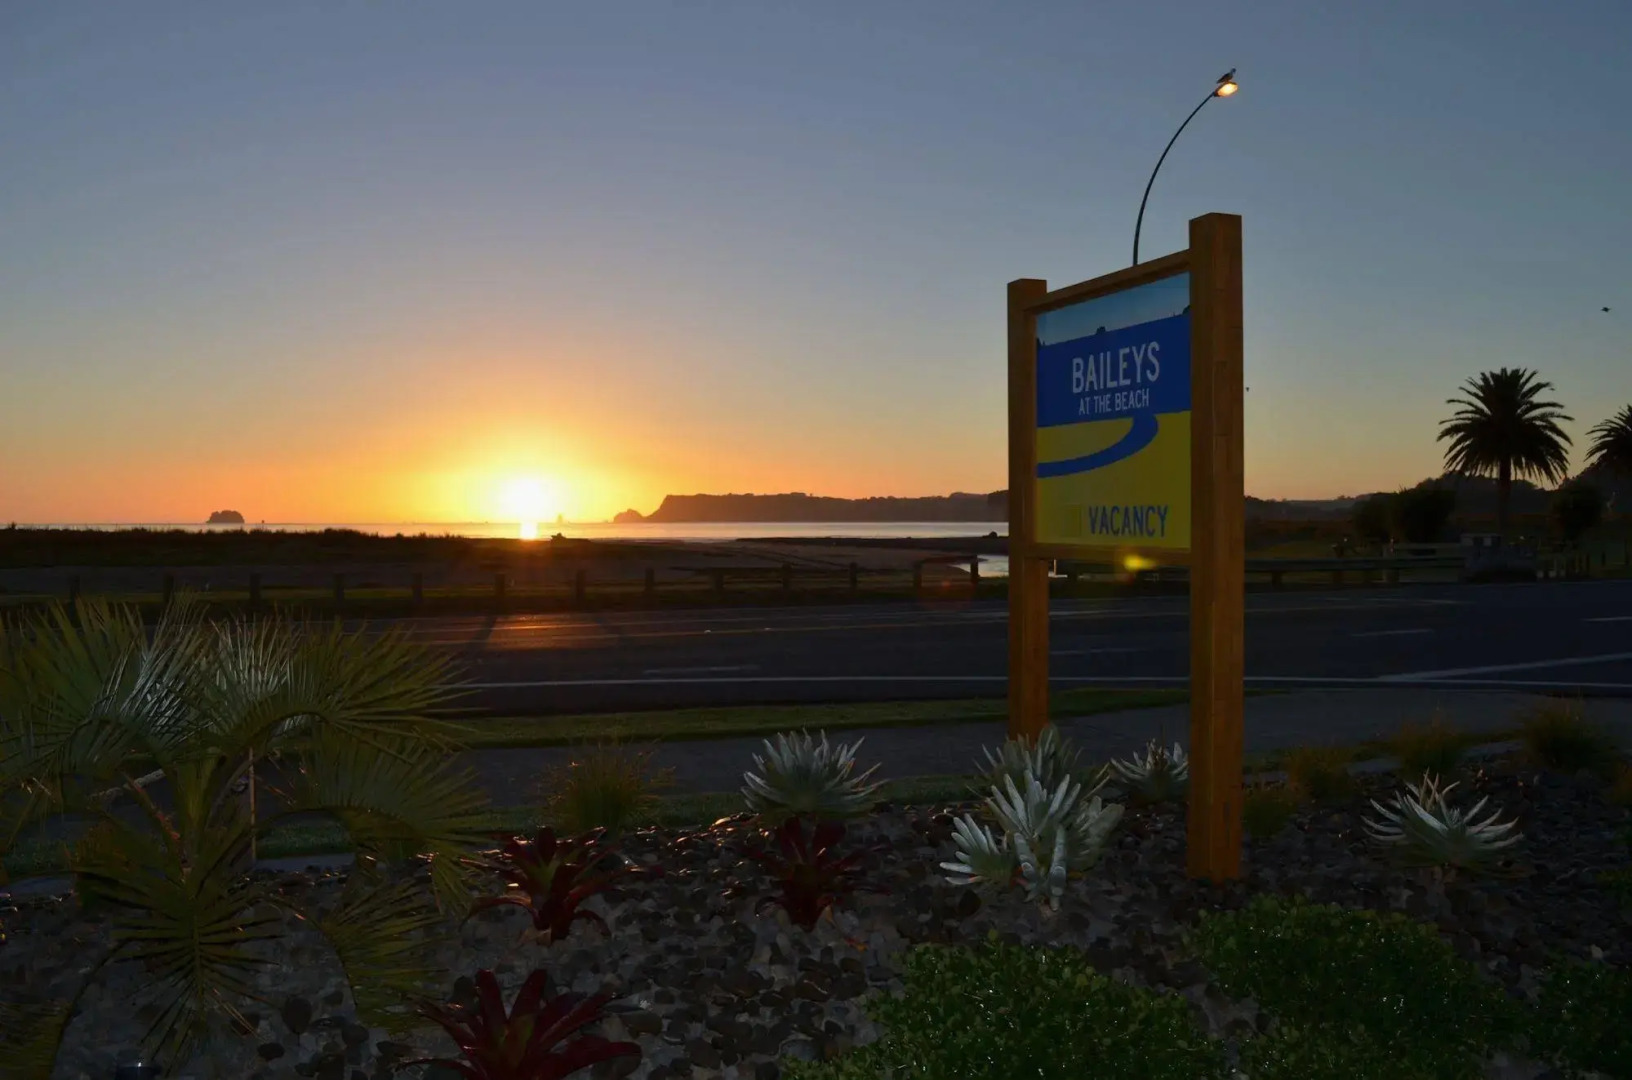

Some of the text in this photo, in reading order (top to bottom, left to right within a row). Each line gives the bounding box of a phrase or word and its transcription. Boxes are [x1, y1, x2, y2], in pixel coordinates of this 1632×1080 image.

[1072, 341, 1160, 393] BAILEYS
[1079, 388, 1149, 415] AT THE BEACH
[1089, 505, 1168, 537] VACANCY
